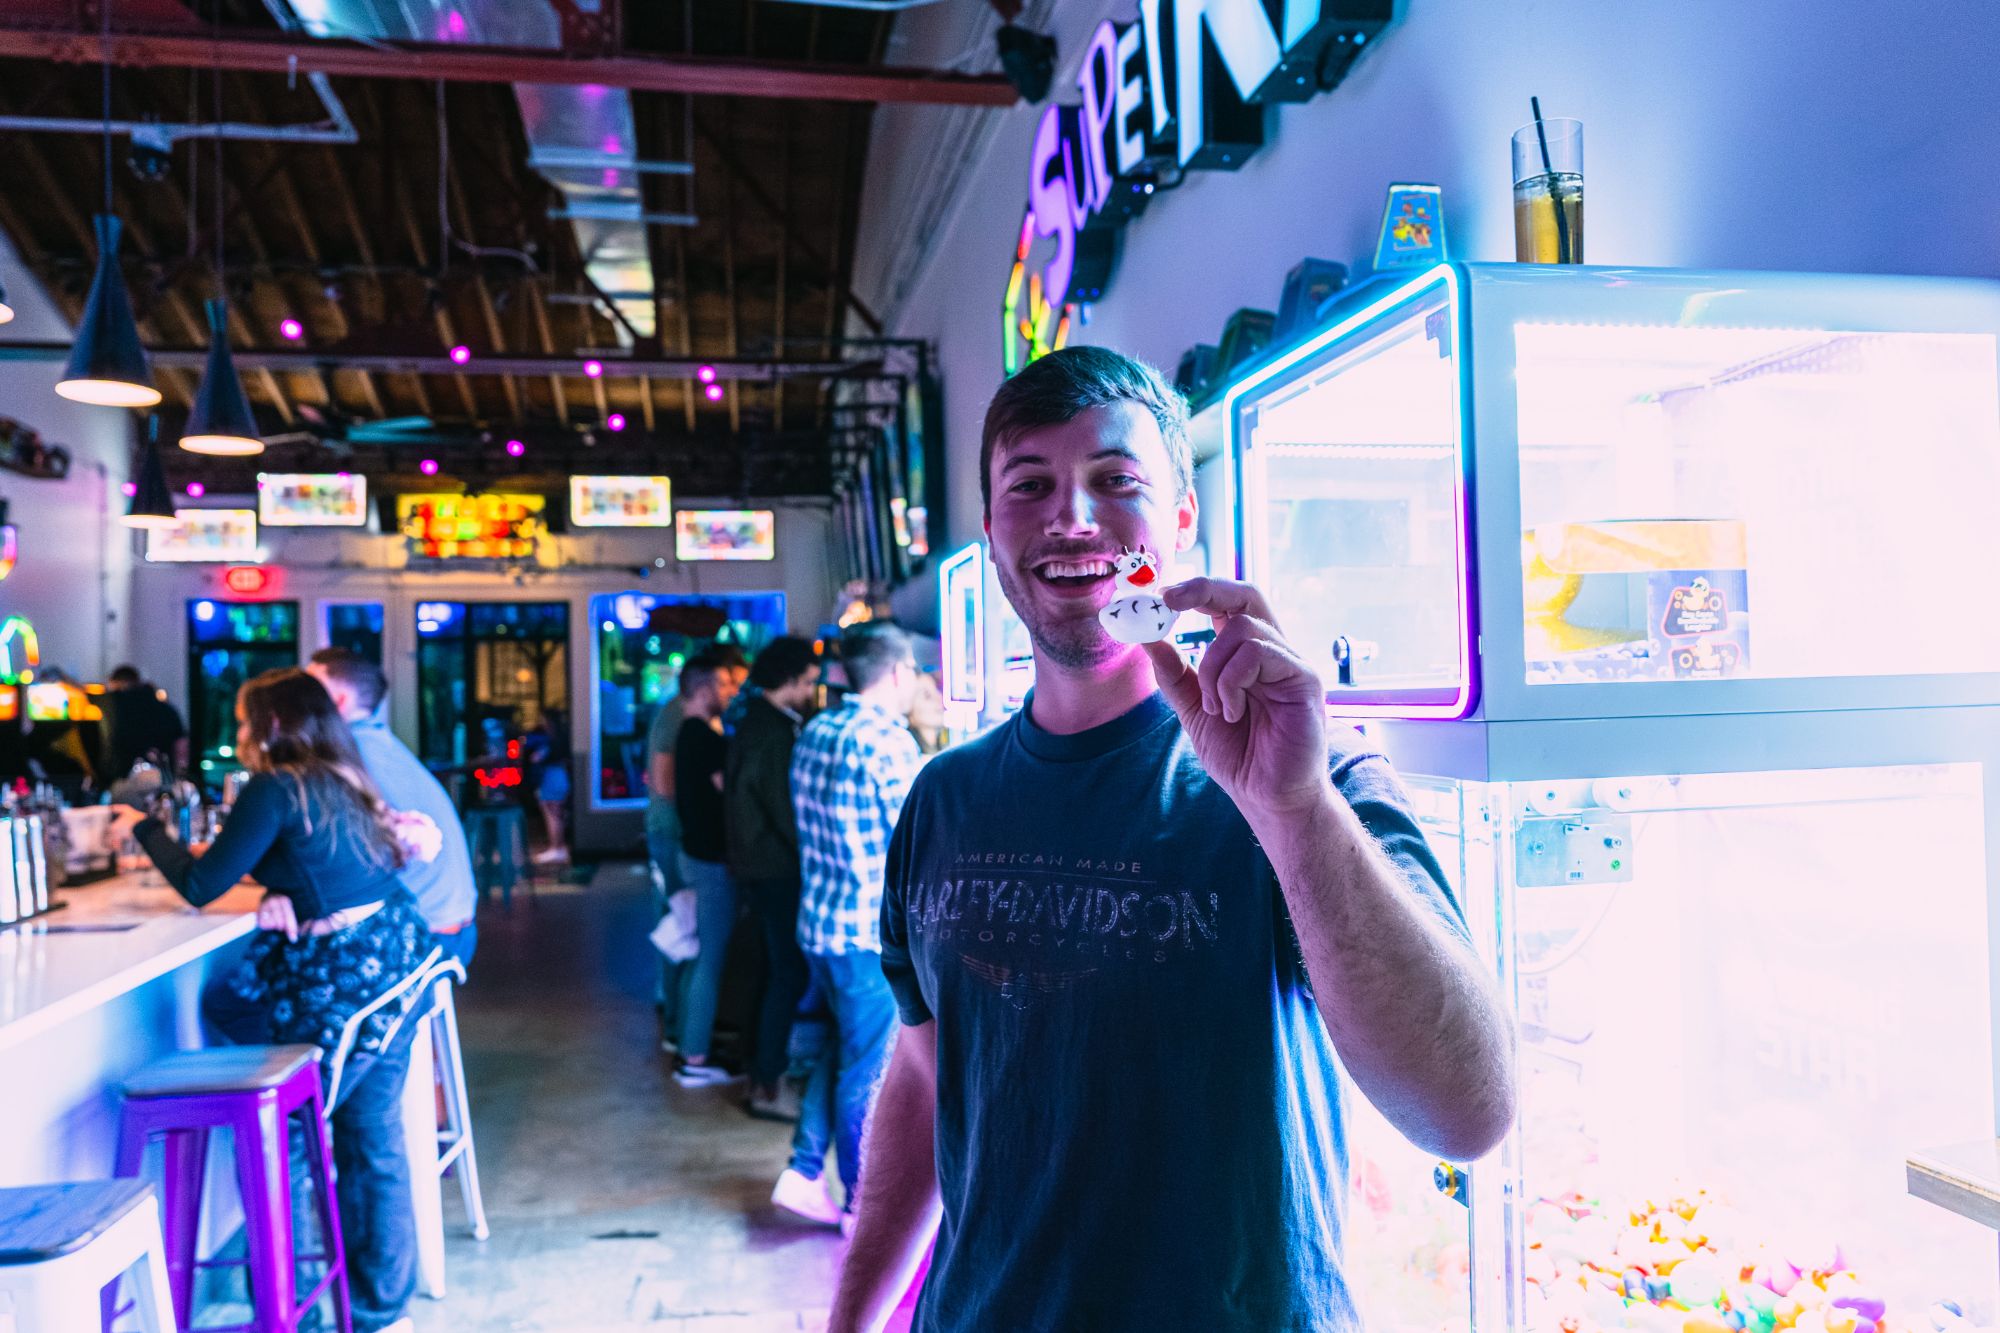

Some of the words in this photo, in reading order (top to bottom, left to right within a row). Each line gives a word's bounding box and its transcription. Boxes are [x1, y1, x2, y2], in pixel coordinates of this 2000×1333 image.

[955, 853, 1063, 867] AMERICAN
[1076, 858, 1142, 874] MADE
[906, 879, 1219, 951] HARLEY-DAVIDSON
[939, 929, 1167, 963] OTORCYCLES
